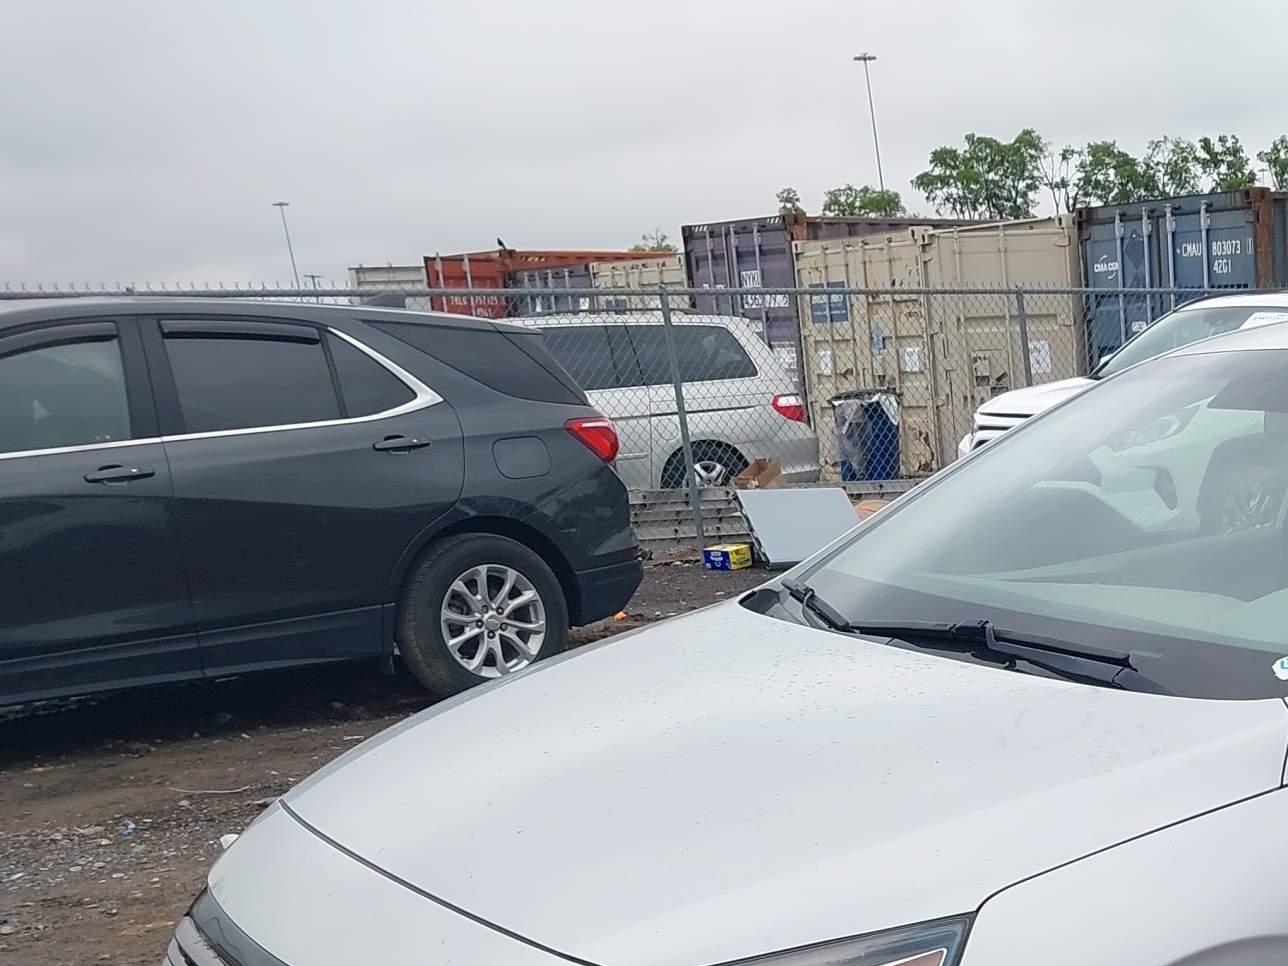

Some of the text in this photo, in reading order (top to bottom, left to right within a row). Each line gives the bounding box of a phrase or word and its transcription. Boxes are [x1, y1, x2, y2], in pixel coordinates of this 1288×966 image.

[1182, 243, 1202, 257] CMAU
[1212, 240, 1241, 256] 803073
[1213, 259, 1232, 273] 42G1
